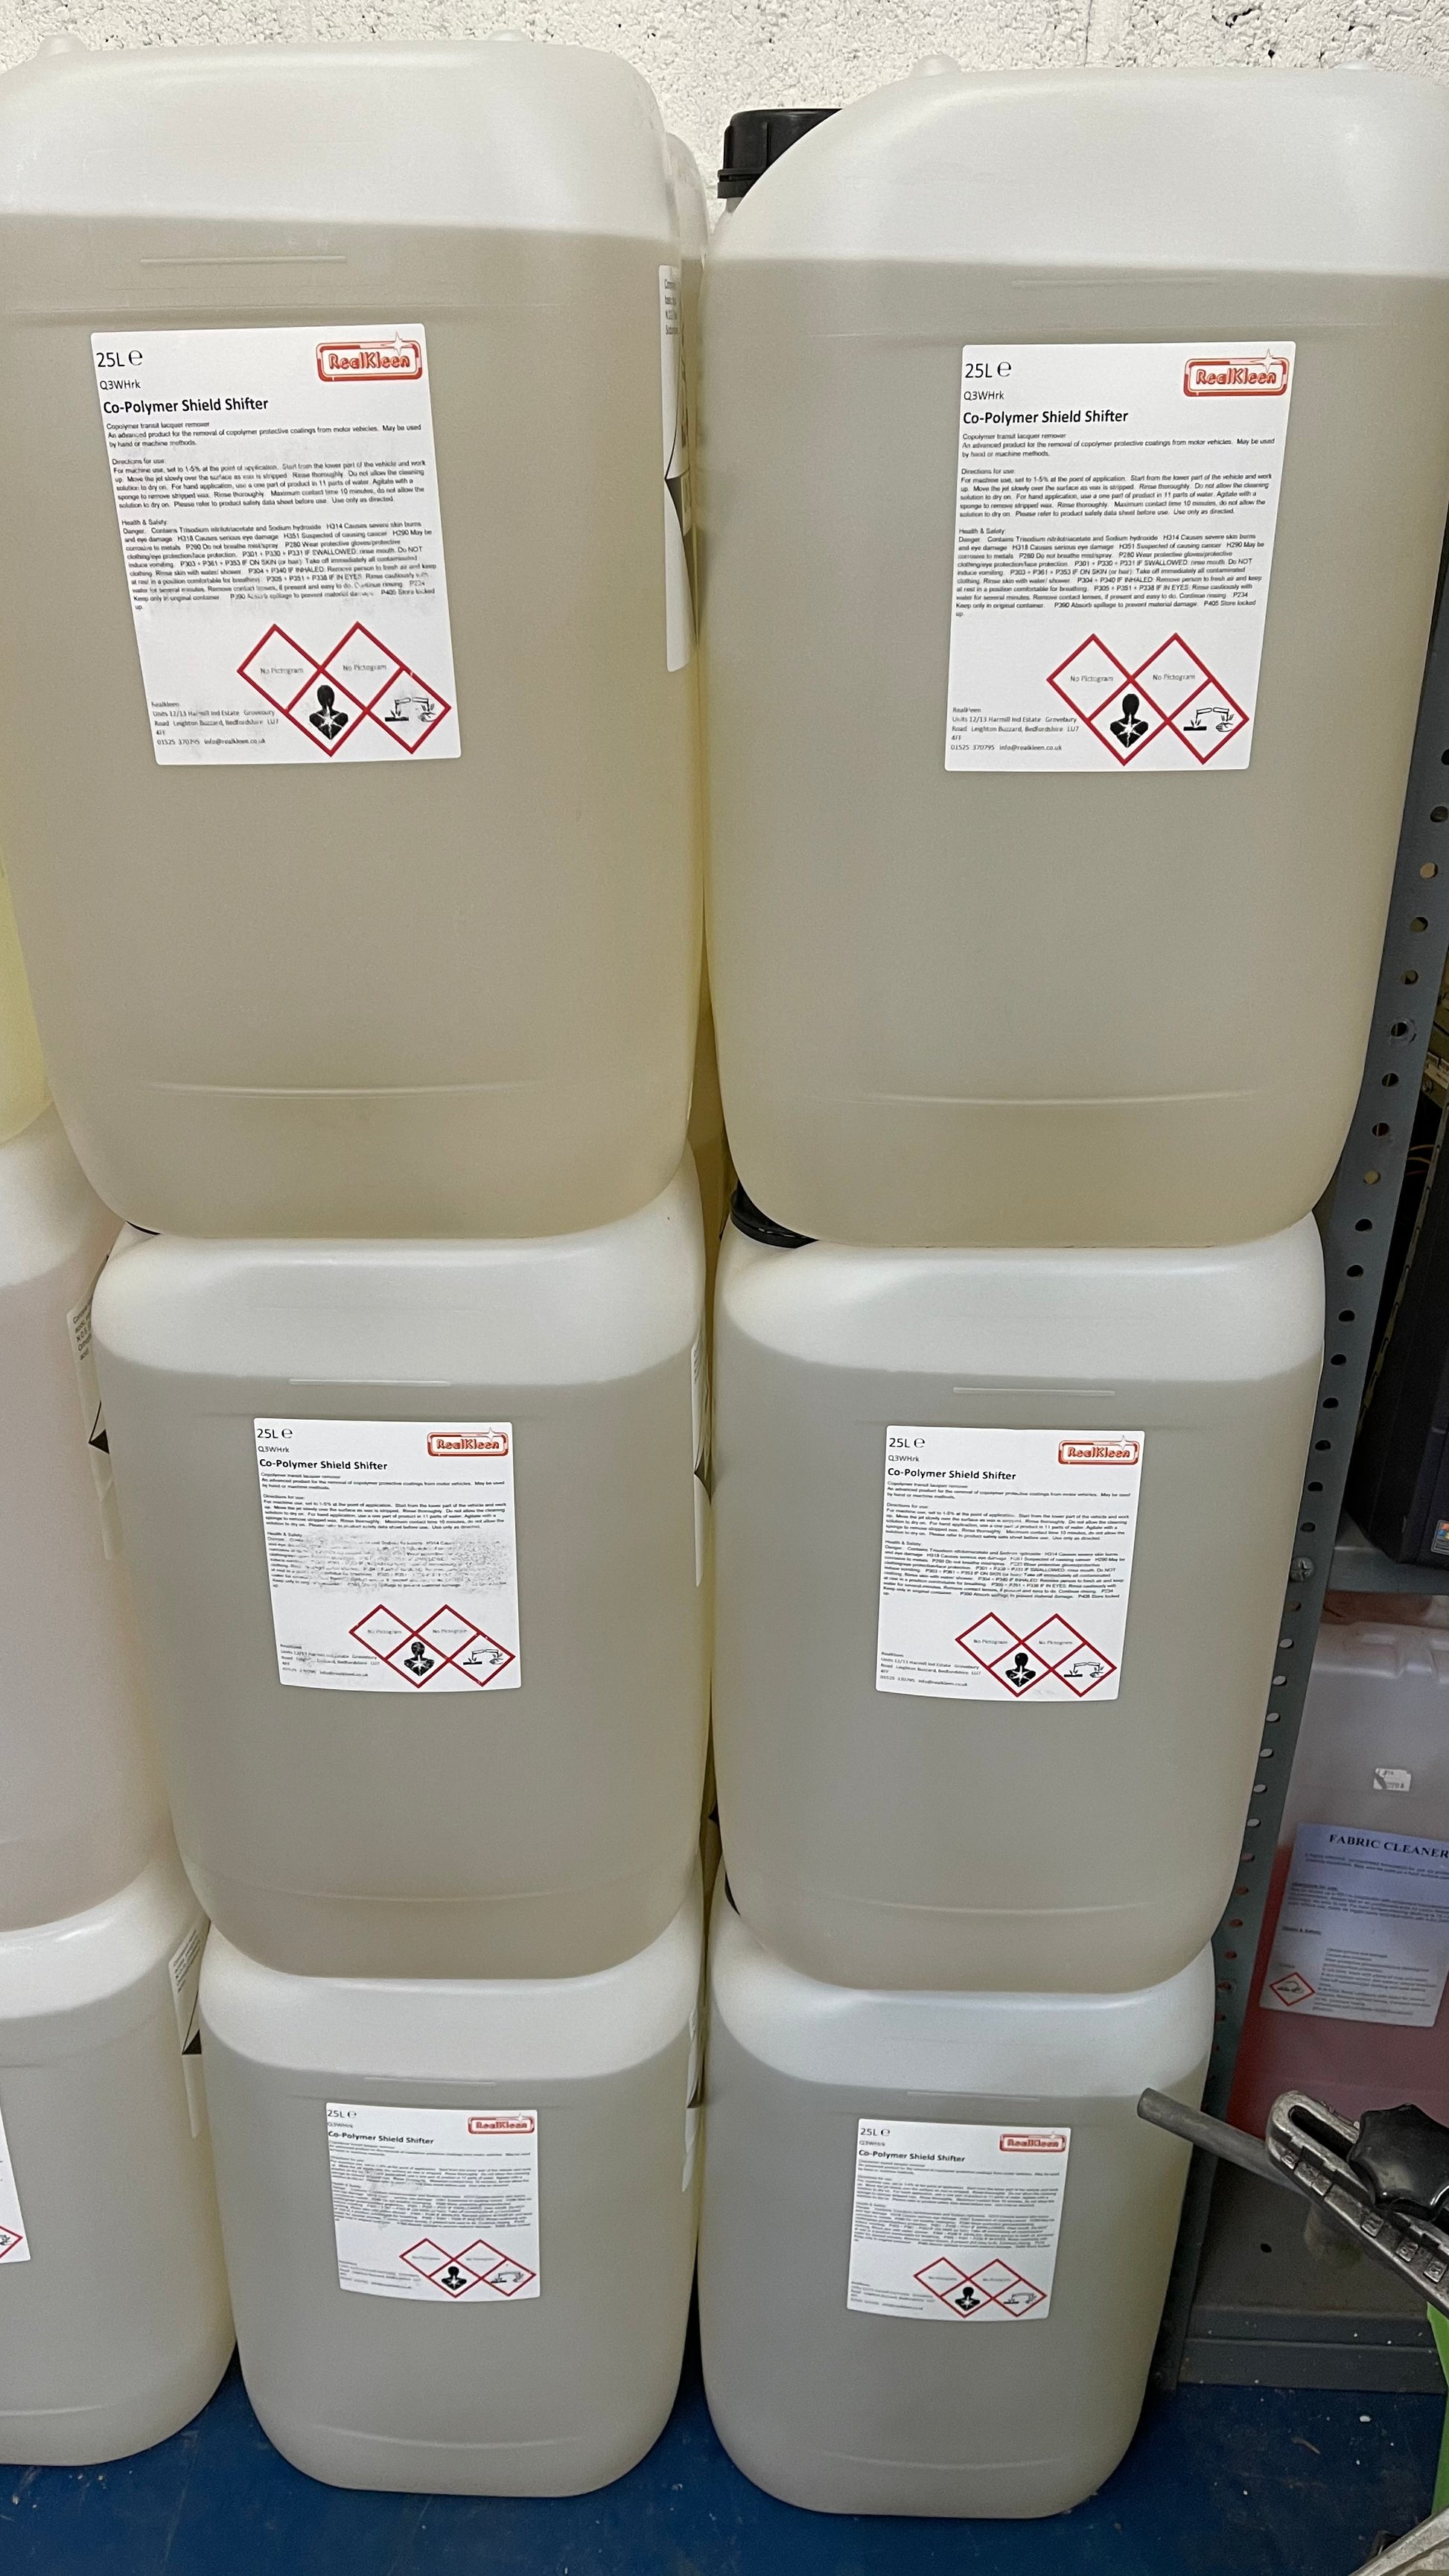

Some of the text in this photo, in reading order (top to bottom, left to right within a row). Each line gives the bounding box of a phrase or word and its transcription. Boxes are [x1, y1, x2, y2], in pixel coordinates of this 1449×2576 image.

[95, 351, 125, 368] 25L
[328, 352, 411, 370] RealKleen
[965, 363, 993, 378] 25L
[1195, 368, 1277, 385] RealKleen
[100, 380, 141, 390] Q3WHrk
[964, 390, 1004, 401] Q3WHrk
[103, 398, 268, 415] Co-Polymer Shield Shifter
[964, 409, 1129, 426] Co-Polymer Shield Shifter
[106, 423, 139, 431] Copolymer
[161, 421, 183, 430] lacquer
[962, 433, 996, 441] Copolymer
[1017, 433, 1040, 441] lacquer
[1002, 441, 1026, 450] product
[1080, 440, 1112, 448] copolymer
[1114, 440, 1144, 448] protective
[1145, 439, 1171, 447] coatings
[962, 451, 969, 459] by
[1191, 474, 1203, 482] part
[1001, 485, 1010, 493] jet
[1011, 485, 1030, 493] slowly
[1109, 484, 1134, 492] stripped.
[1243, 482, 1270, 491] cleaning
[1081, 675, 1114, 683] Pictogram
[1163, 673, 1196, 681] Pictogram
[1045, 716, 1077, 724] Grovebury
[256, 1428, 278, 1438] 25L
[436, 1439, 500, 1450] RealKleen
[889, 1438, 910, 1447] 25L
[1067, 1447, 1130, 1458] RealKleen
[259, 1459, 387, 1470] Co-Polymer Shield Shifter
[888, 1468, 1016, 1480] Co-Polymer Shield Shifter
[1329, 1834, 1449, 1858] FABRIC CLEANER
[328, 2110, 344, 2119] 25L
[328, 2131, 377, 2141] Co-Polymer
[861, 2128, 877, 2137] 25L
[859, 2150, 907, 2159] Co-Polymer
